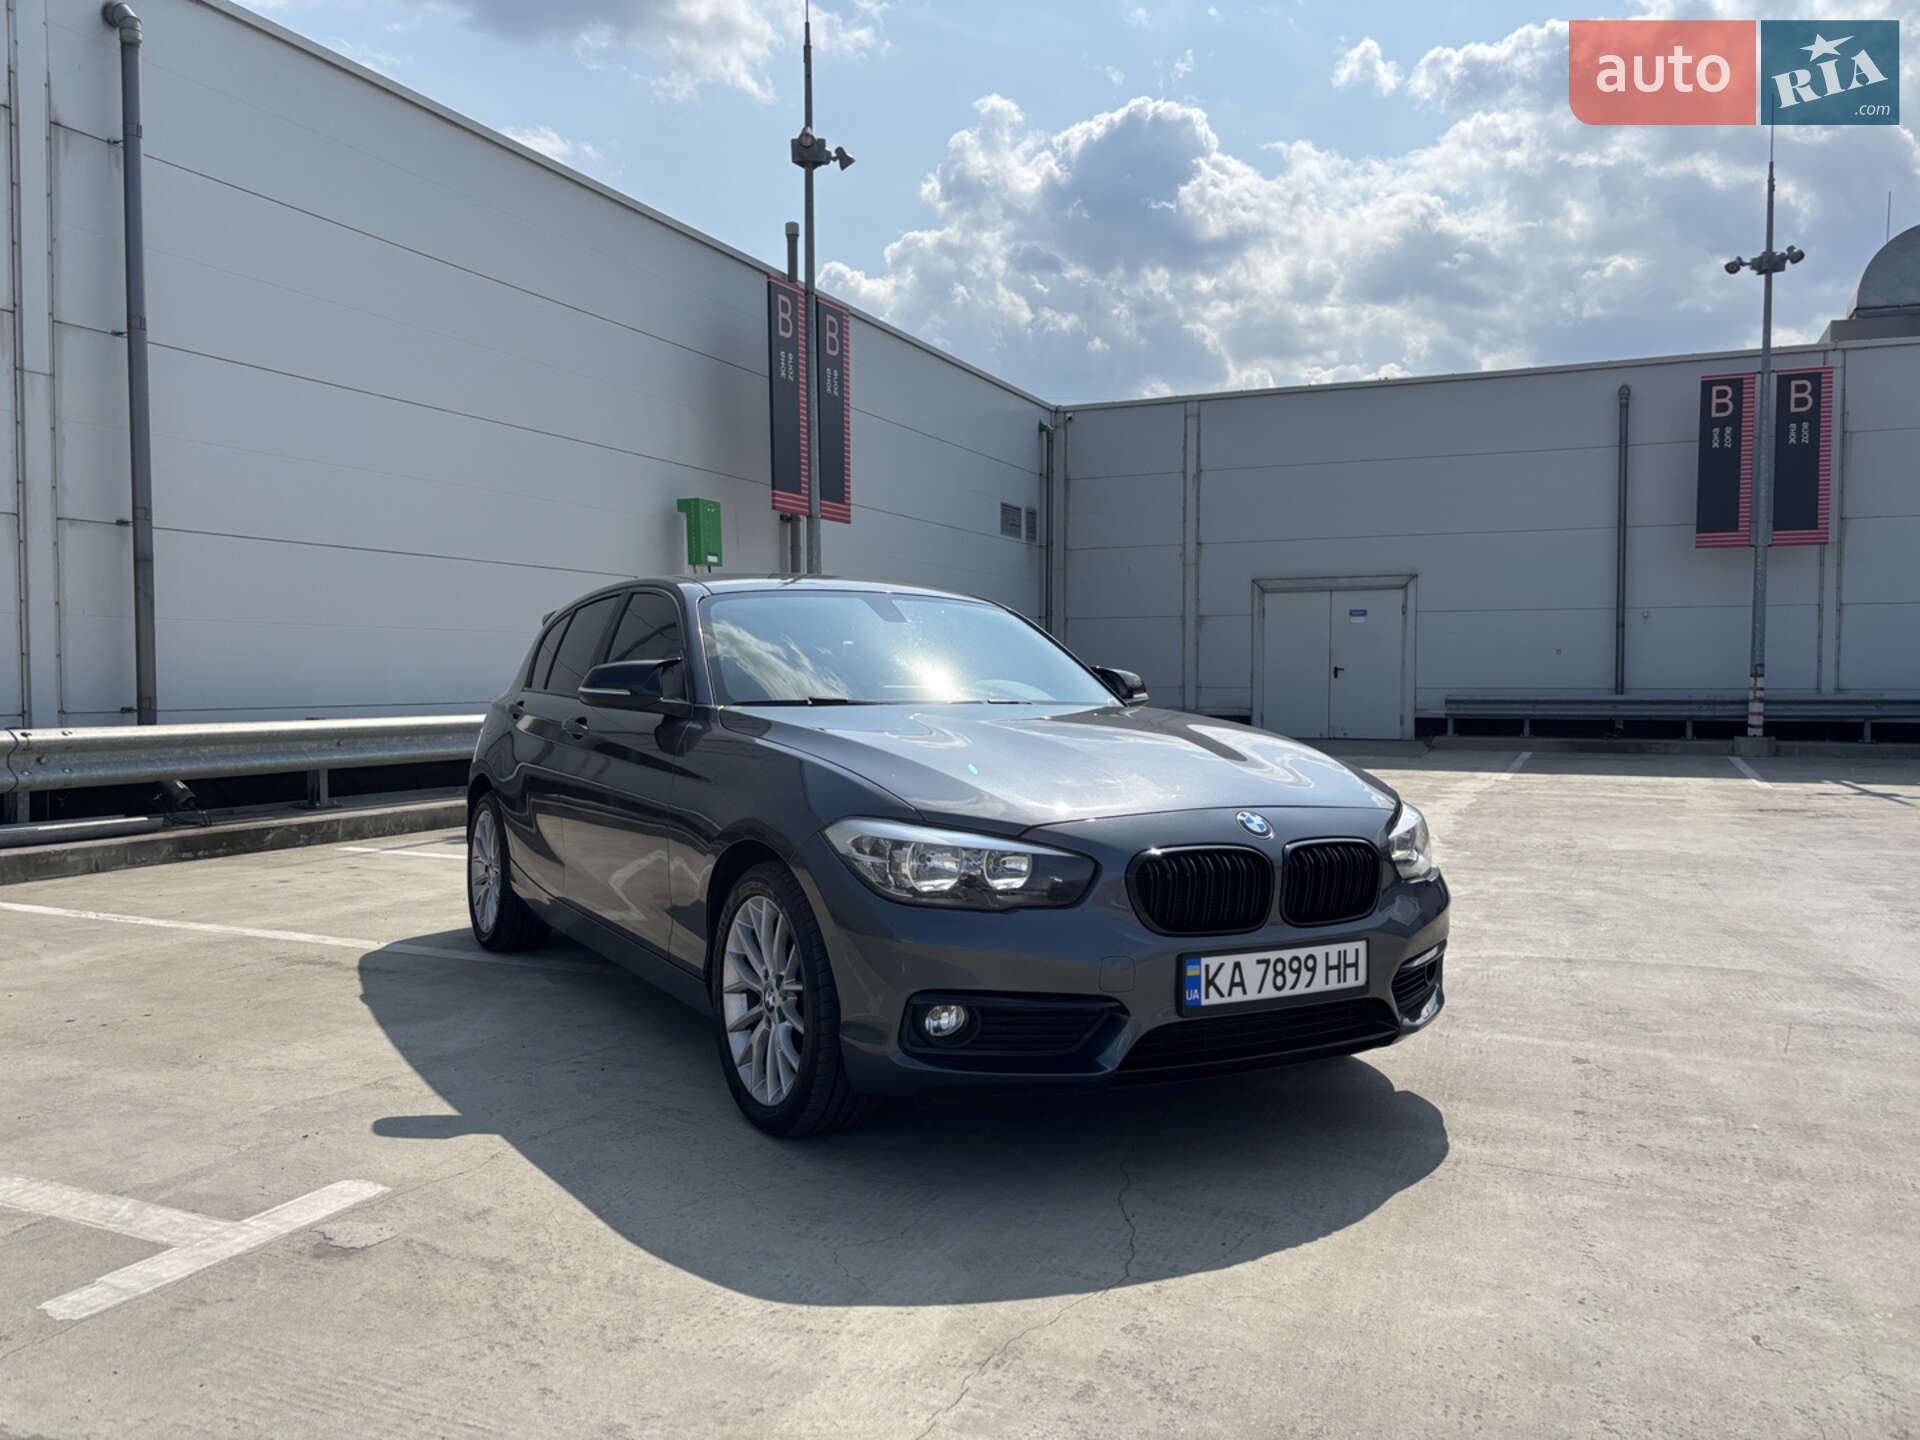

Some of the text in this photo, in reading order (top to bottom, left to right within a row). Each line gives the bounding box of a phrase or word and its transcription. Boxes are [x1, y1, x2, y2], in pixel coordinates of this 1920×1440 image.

[778, 294, 793, 338] B
[826, 314, 840, 357] B
[1711, 385, 1734, 418] B
[1790, 380, 1813, 413] B
[1204, 948, 1359, 999] KA 7899 HH
[1186, 989, 1200, 1000] UA
